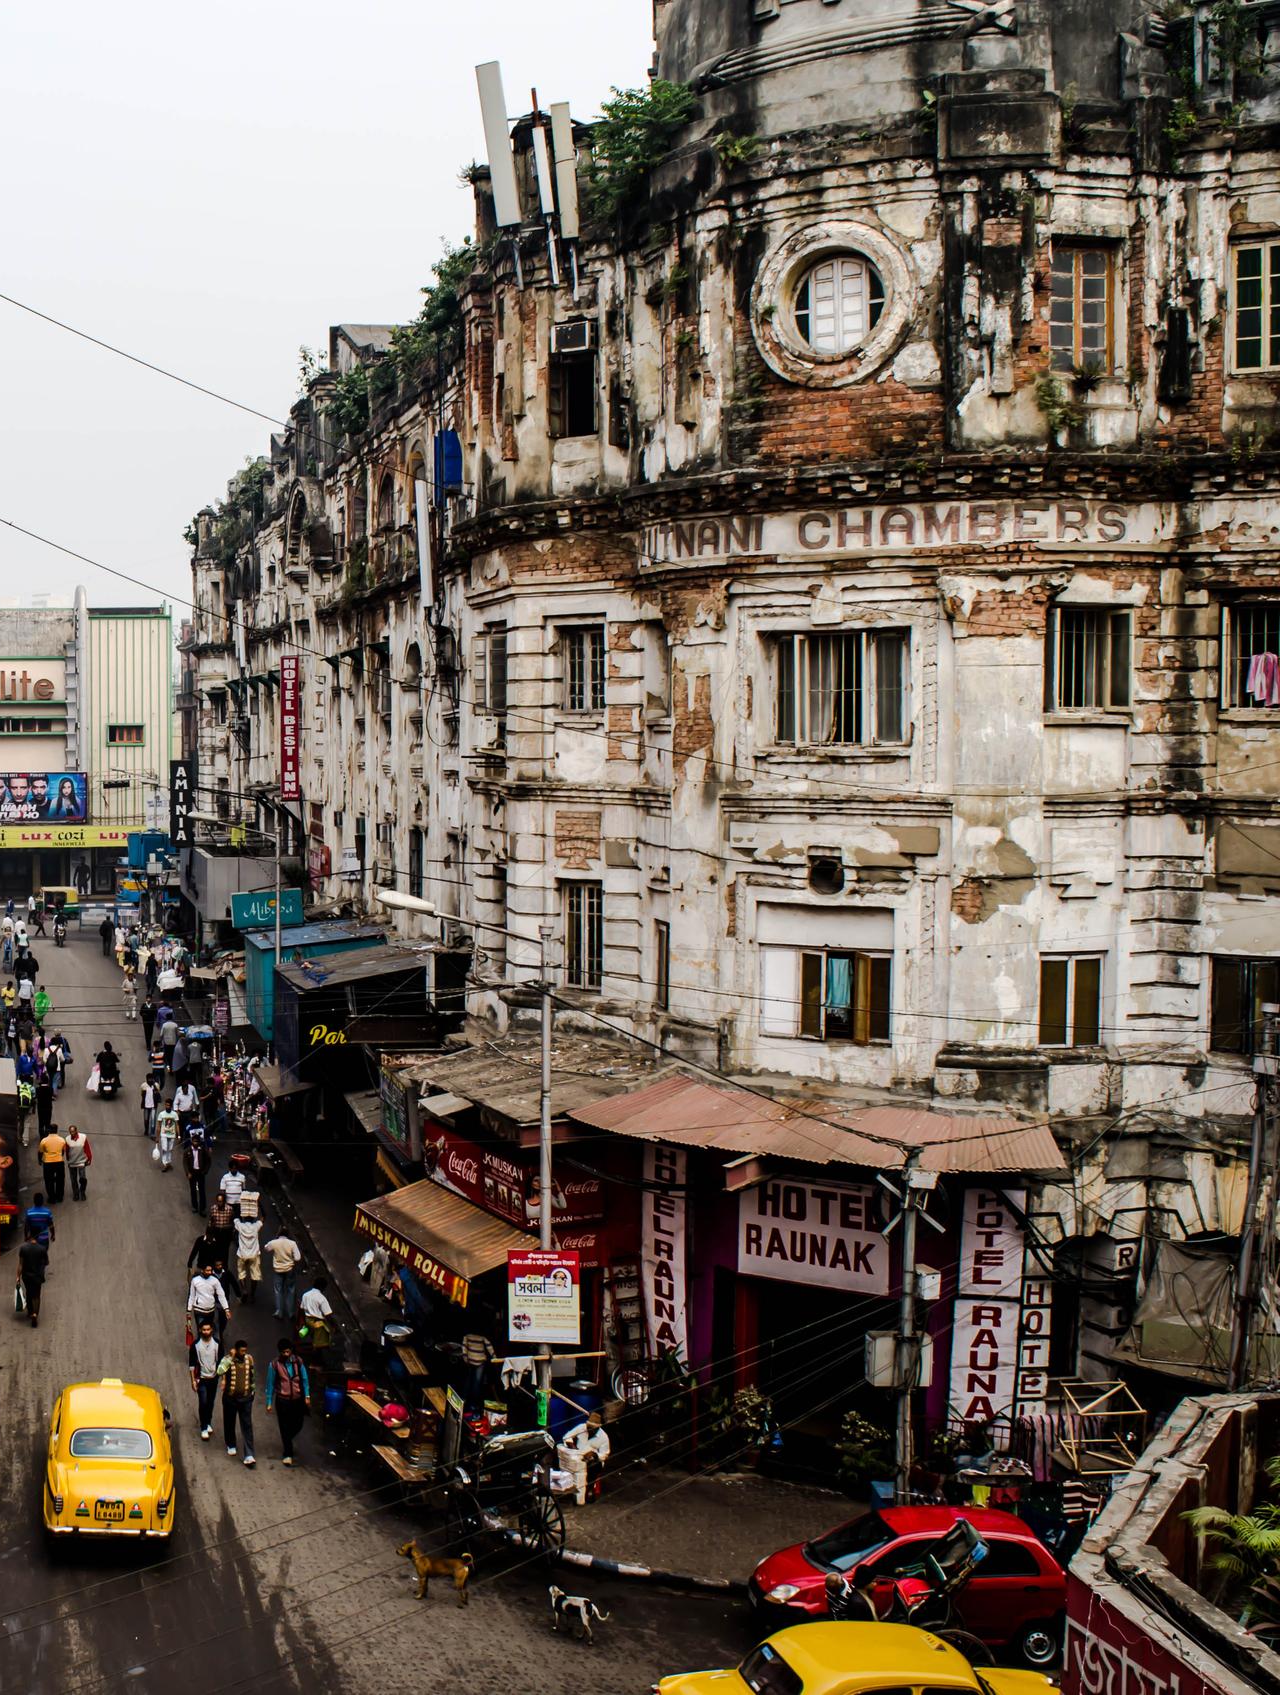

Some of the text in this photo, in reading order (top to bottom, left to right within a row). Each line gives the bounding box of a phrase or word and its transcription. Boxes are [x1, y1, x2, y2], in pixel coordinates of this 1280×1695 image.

[798, 502, 1128, 550] CHAMBERS
[283, 659, 296, 792] HOTEL BEST INN
[175, 766, 188, 841] AMINIA
[57, 829, 84, 841] cozi
[492, 1155, 523, 1182] MUSKAN
[652, 1147, 677, 1237] HOEL
[758, 1182, 882, 1234] HOTEL
[972, 1192, 1004, 1285] HOTEL
[359, 1215, 445, 1286] MUSKAN ROLL
[745, 1223, 876, 1275] RAUNAK
